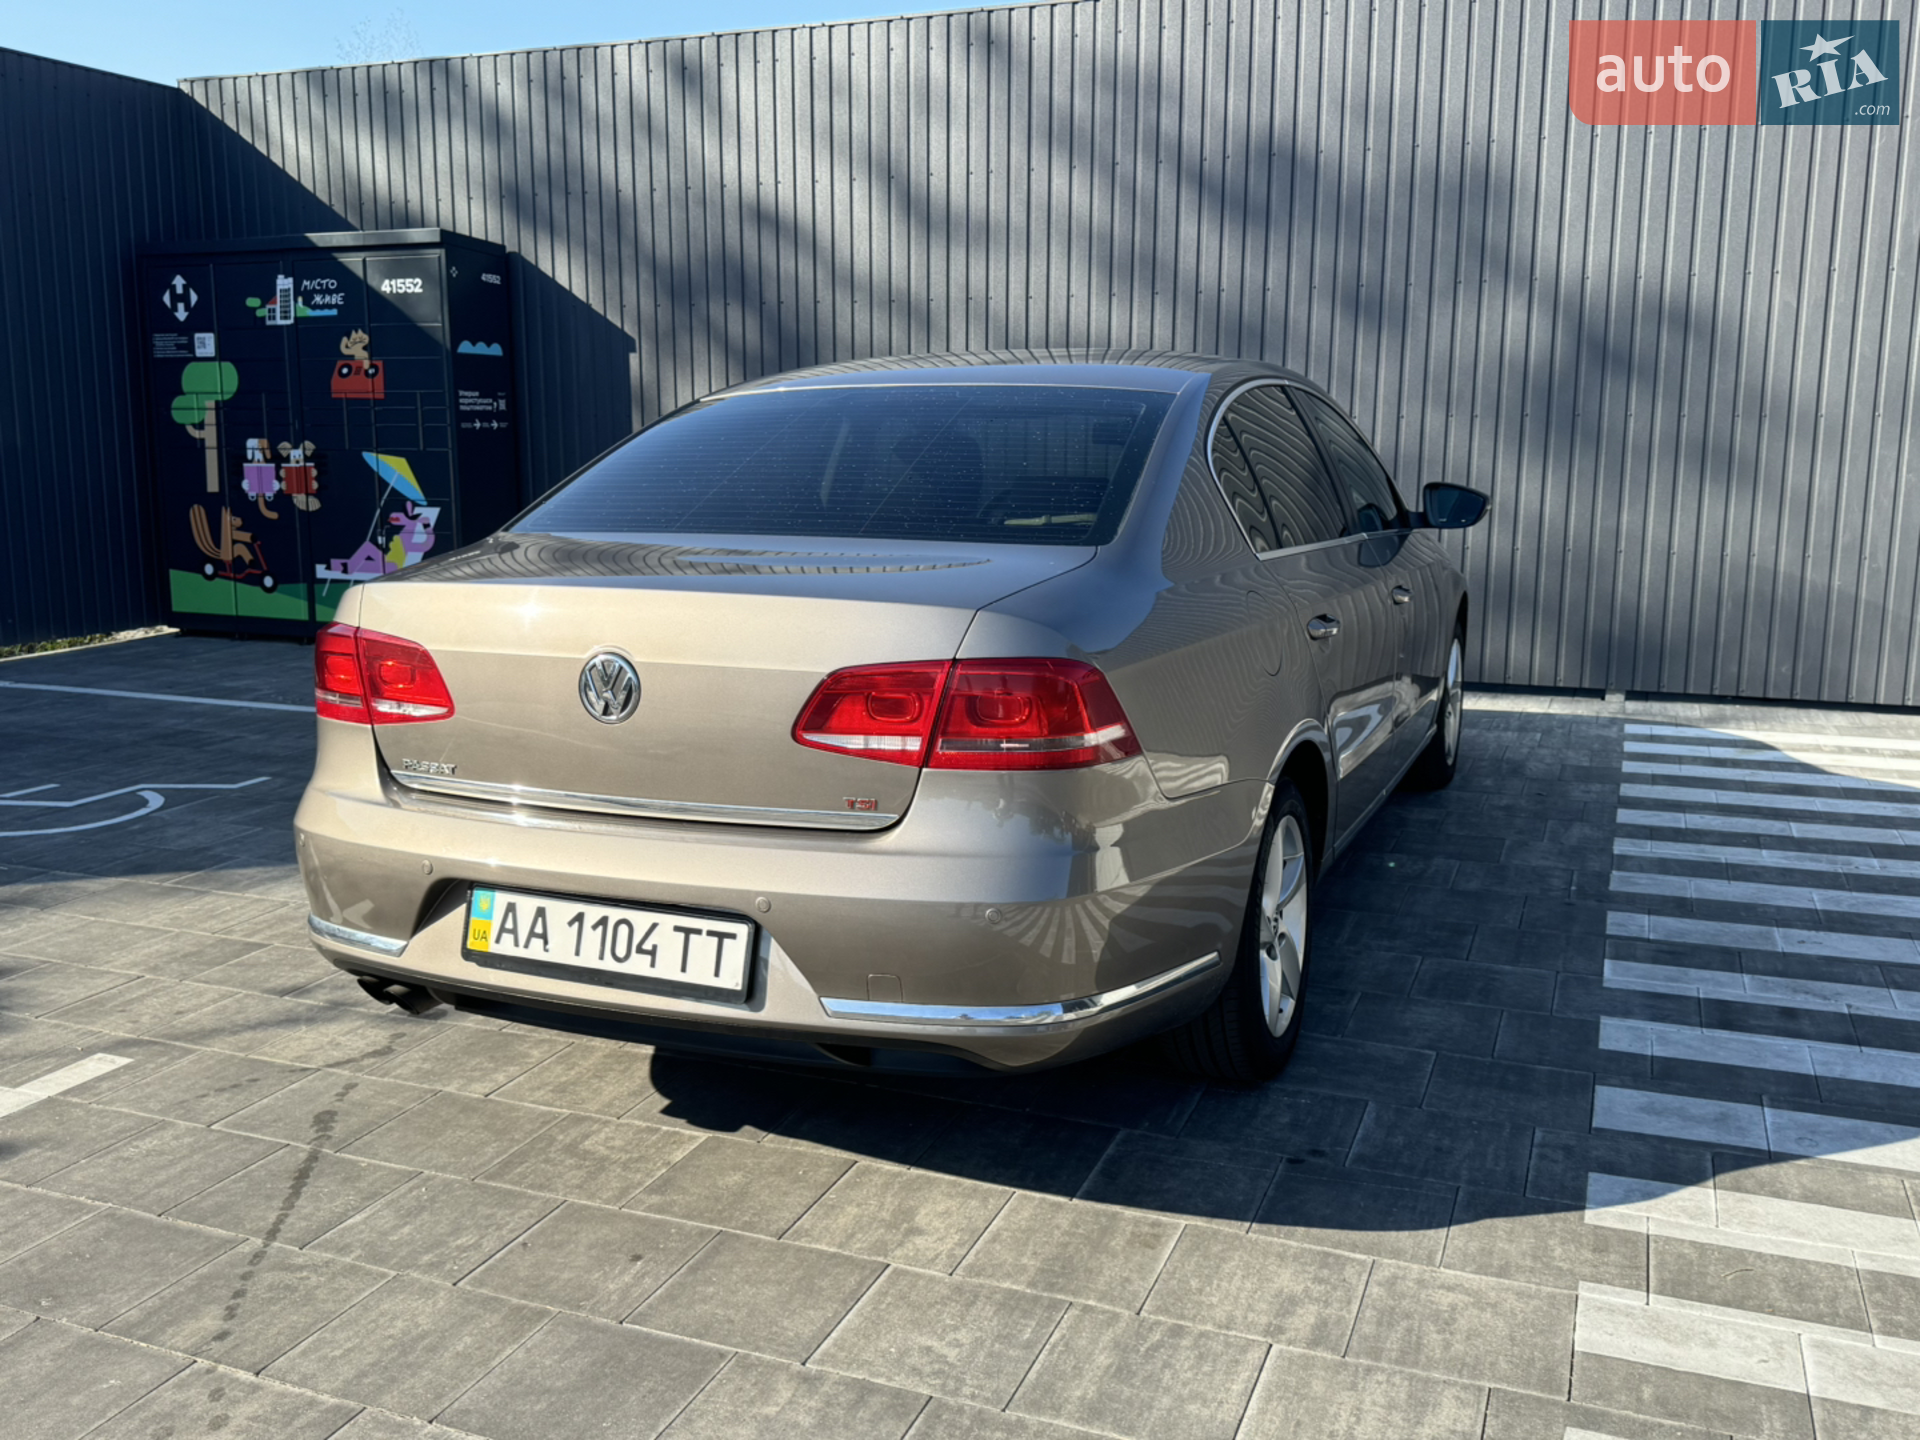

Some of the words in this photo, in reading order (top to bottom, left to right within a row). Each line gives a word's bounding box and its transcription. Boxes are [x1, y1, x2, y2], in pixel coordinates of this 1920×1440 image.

[301, 278, 338, 291] МІСТО
[381, 277, 424, 294] 41552
[480, 272, 502, 285] 41552
[311, 293, 345, 305] ЖИВЕ
[843, 796, 878, 811] TSI
[472, 927, 489, 942] UA
[494, 901, 550, 952] AA
[567, 911, 660, 968] 1104
[672, 925, 738, 978] TT
